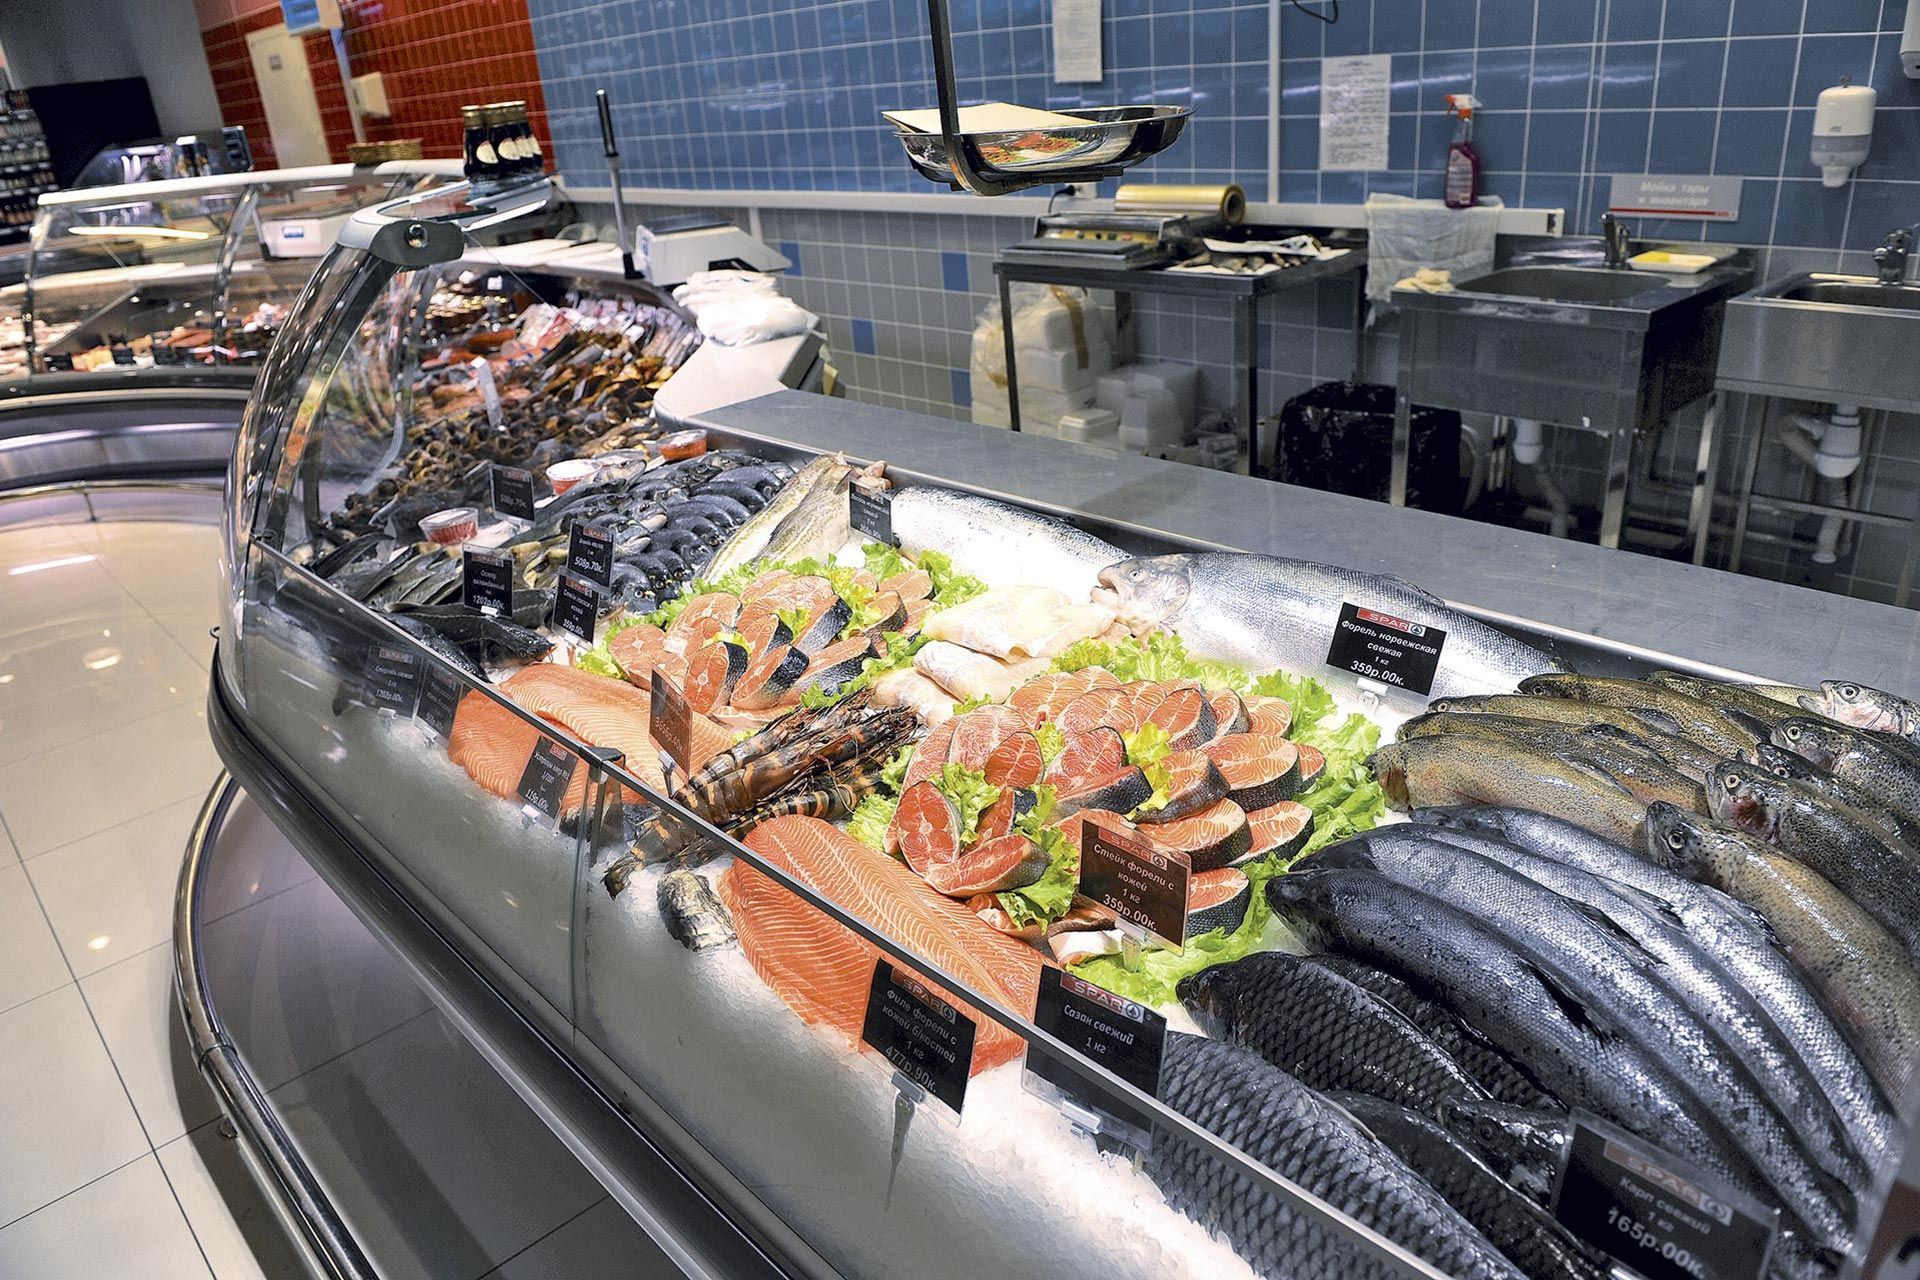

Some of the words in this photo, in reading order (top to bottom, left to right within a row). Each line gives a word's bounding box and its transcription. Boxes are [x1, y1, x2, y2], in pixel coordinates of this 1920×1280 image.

[1369, 612, 1409, 632] SPAR
[1341, 620, 1377, 637] Форель
[1379, 633, 1438, 656] норвежская
[1367, 642, 1402, 658] свежая
[1350, 660, 1405, 686] 359р.00к.
[1110, 834, 1151, 860] SPAR
[1093, 843, 1126, 866] Стейк
[1127, 860, 1166, 886] форели
[1168, 881, 1175, 891] с
[1117, 871, 1147, 891] кожей
[1103, 894, 1157, 931] 359р.00к.
[1129, 893, 1140, 904] кг
[902, 977, 942, 1010] SPAR
[1074, 981, 1123, 1011] SPAR
[886, 989, 911, 1011] Филе
[912, 1007, 950, 1039] форели
[950, 1036, 958, 1046] с
[1063, 1004, 1092, 1026] Сазан
[1093, 1021, 1134, 1045] свежий
[882, 1004, 910, 1030] кожей
[911, 1025, 956, 1063] б/костей
[1086, 1037, 1091, 1048] 1
[1093, 1042, 1106, 1054] кг
[906, 1040, 912, 1050] 1
[913, 1046, 925, 1060] кг
[1626, 1155, 1700, 1203] SPAR
